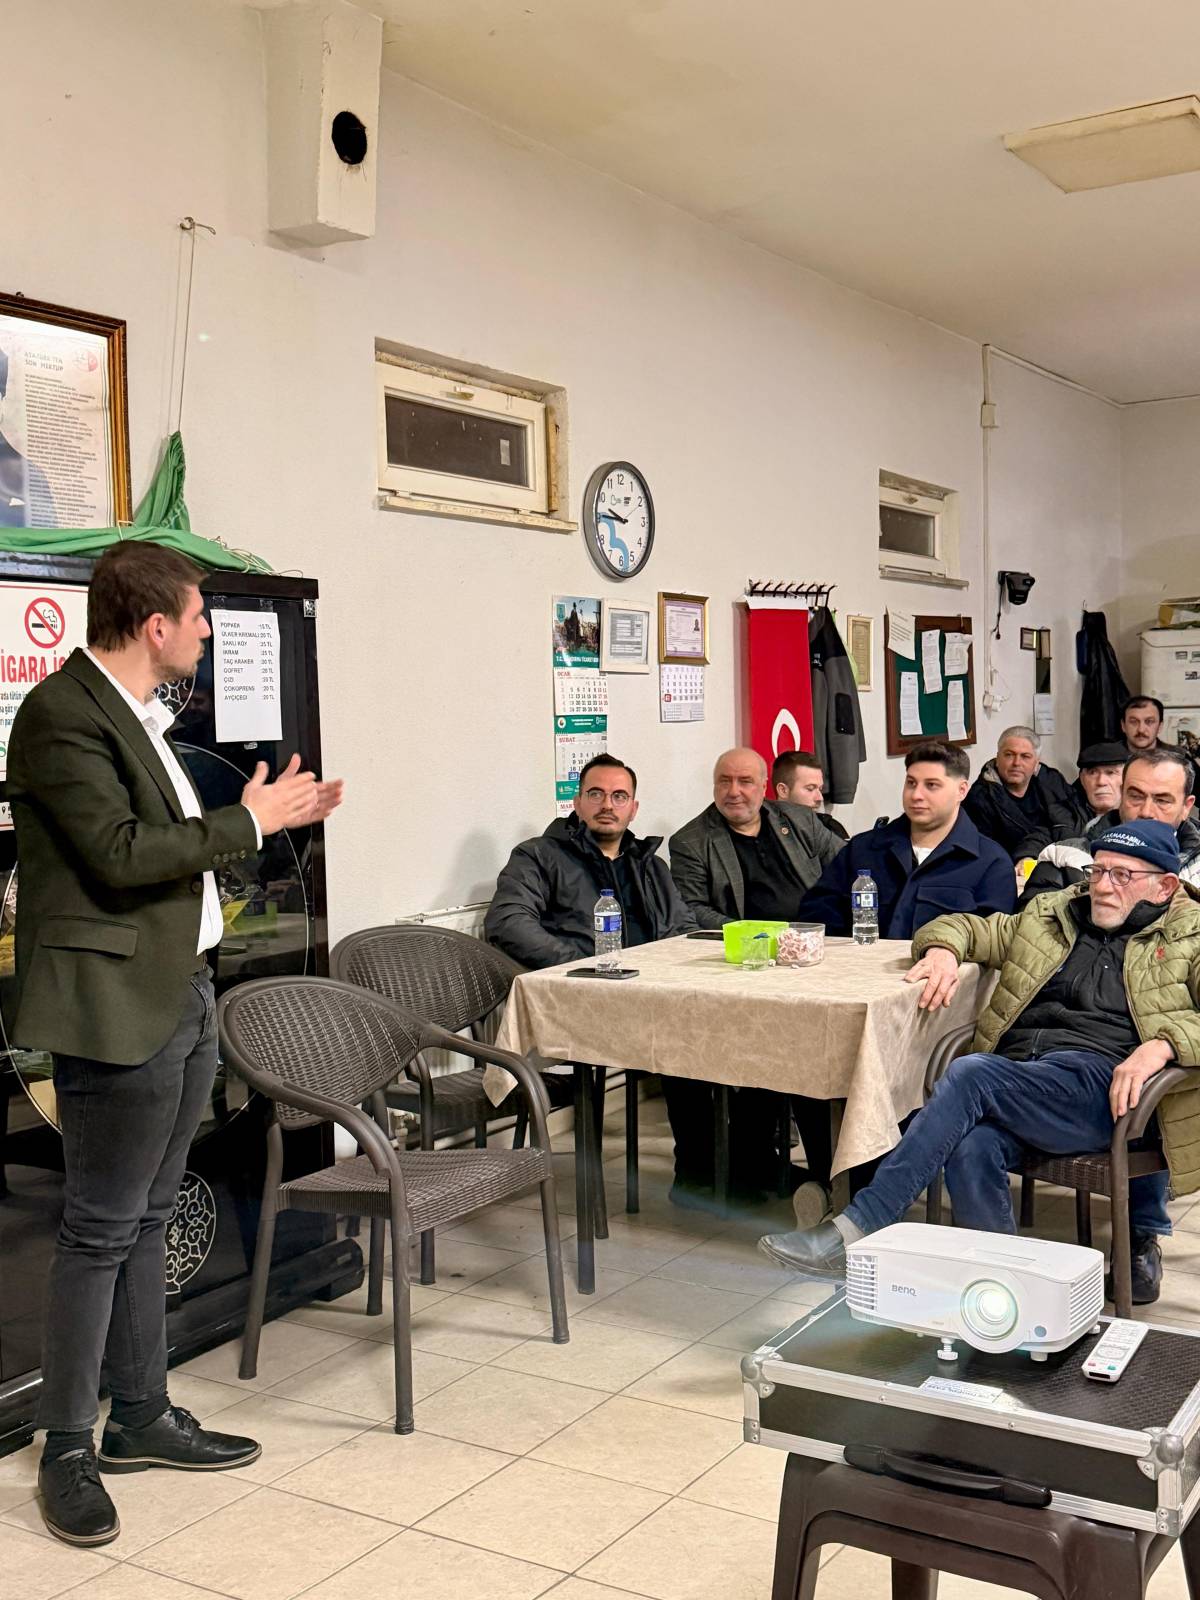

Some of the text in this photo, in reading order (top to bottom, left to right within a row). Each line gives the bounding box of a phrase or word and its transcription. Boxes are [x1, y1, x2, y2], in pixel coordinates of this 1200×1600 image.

[606, 478, 613, 489] 11
[617, 474, 625, 486] 12
[630, 481, 634, 493] 1
[637, 496, 643, 508] 2
[640, 516, 646, 528] 3
[600, 534, 605, 546] 8
[636, 537, 642, 548] 4
[607, 549, 613, 560] 7
[629, 551, 635, 562] 5
[618, 555, 624, 567] 6
[891, 1284, 917, 1297] BenQ
